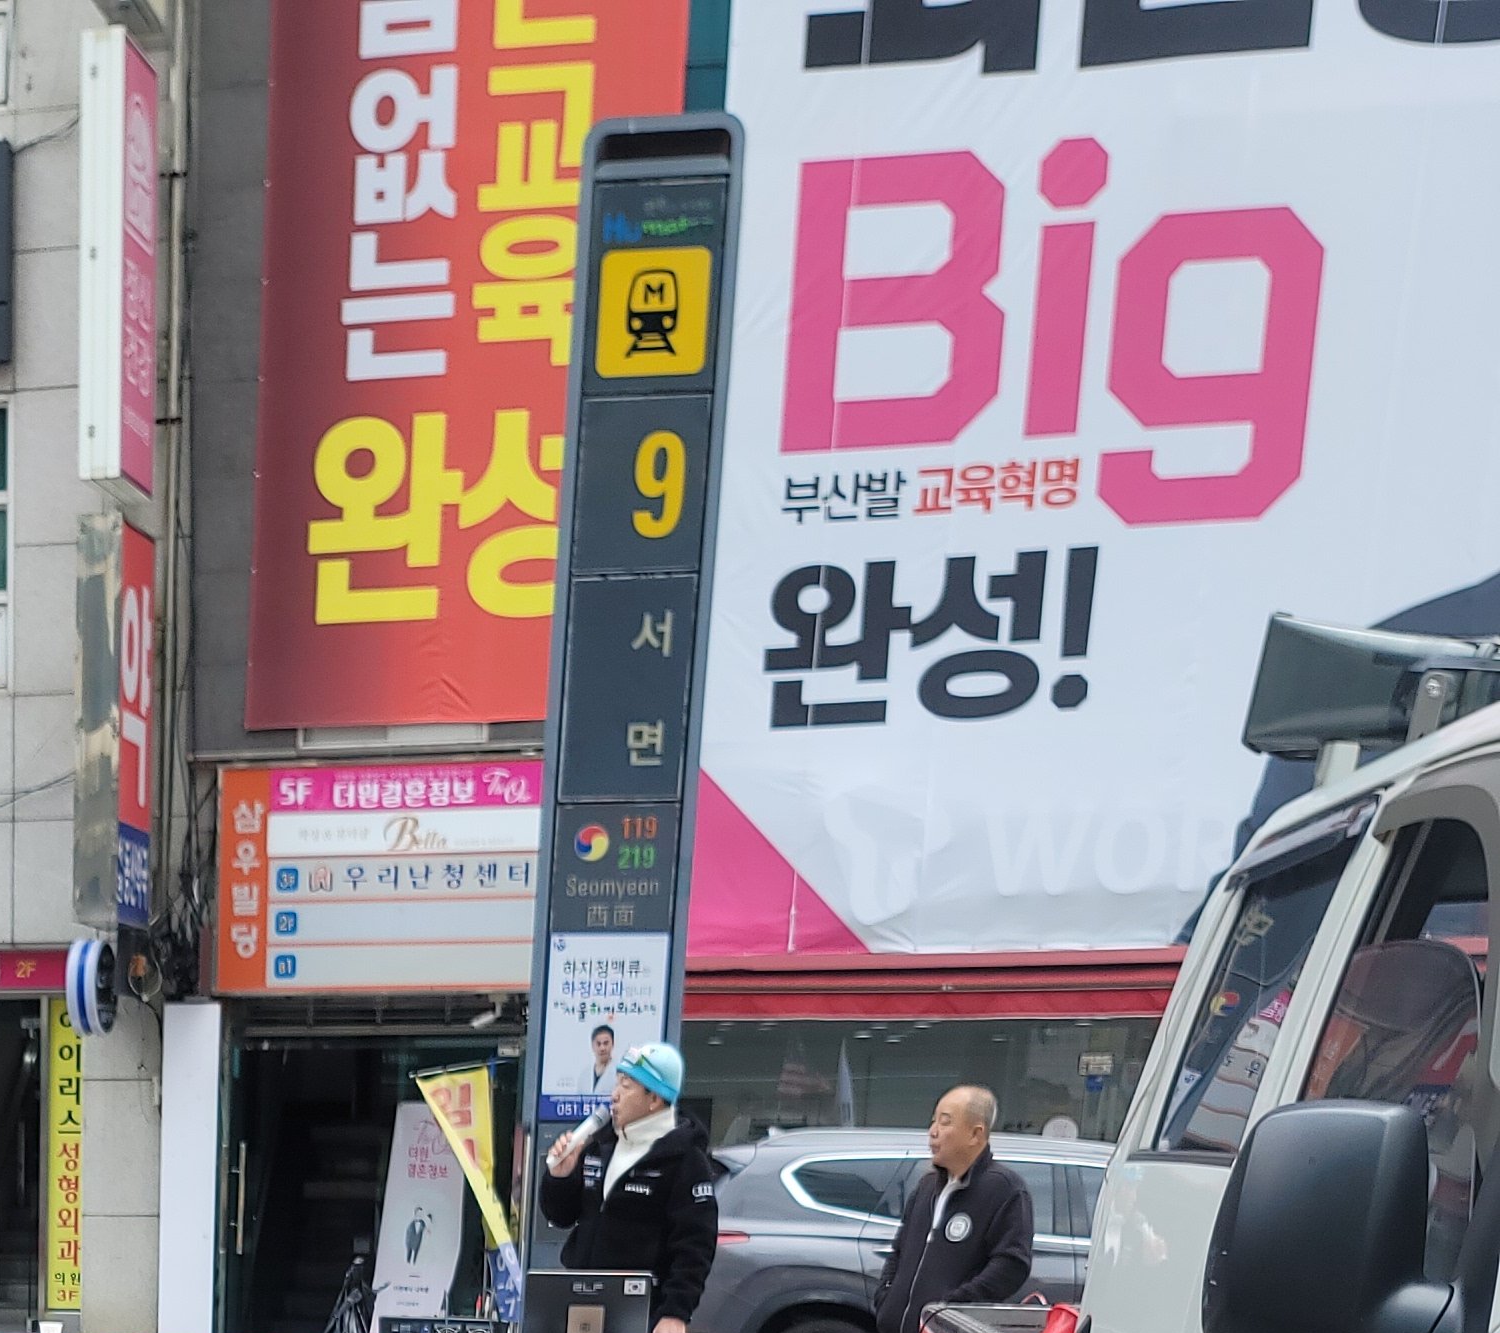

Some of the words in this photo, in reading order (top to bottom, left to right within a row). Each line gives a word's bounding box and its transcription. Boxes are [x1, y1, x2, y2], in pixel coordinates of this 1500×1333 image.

[779, 137, 1325, 528] Big
[631, 430, 687, 540] 9
[780, 466, 908, 524] 부산발
[912, 456, 1082, 517] 교육혁명
[762, 544, 1102, 733] 완성!
[621, 816, 659, 840] 119
[342, 862, 531, 892] 우리난청센터
[565, 873, 660, 900] Seomyeon
[16, 960, 37, 979] 2F
